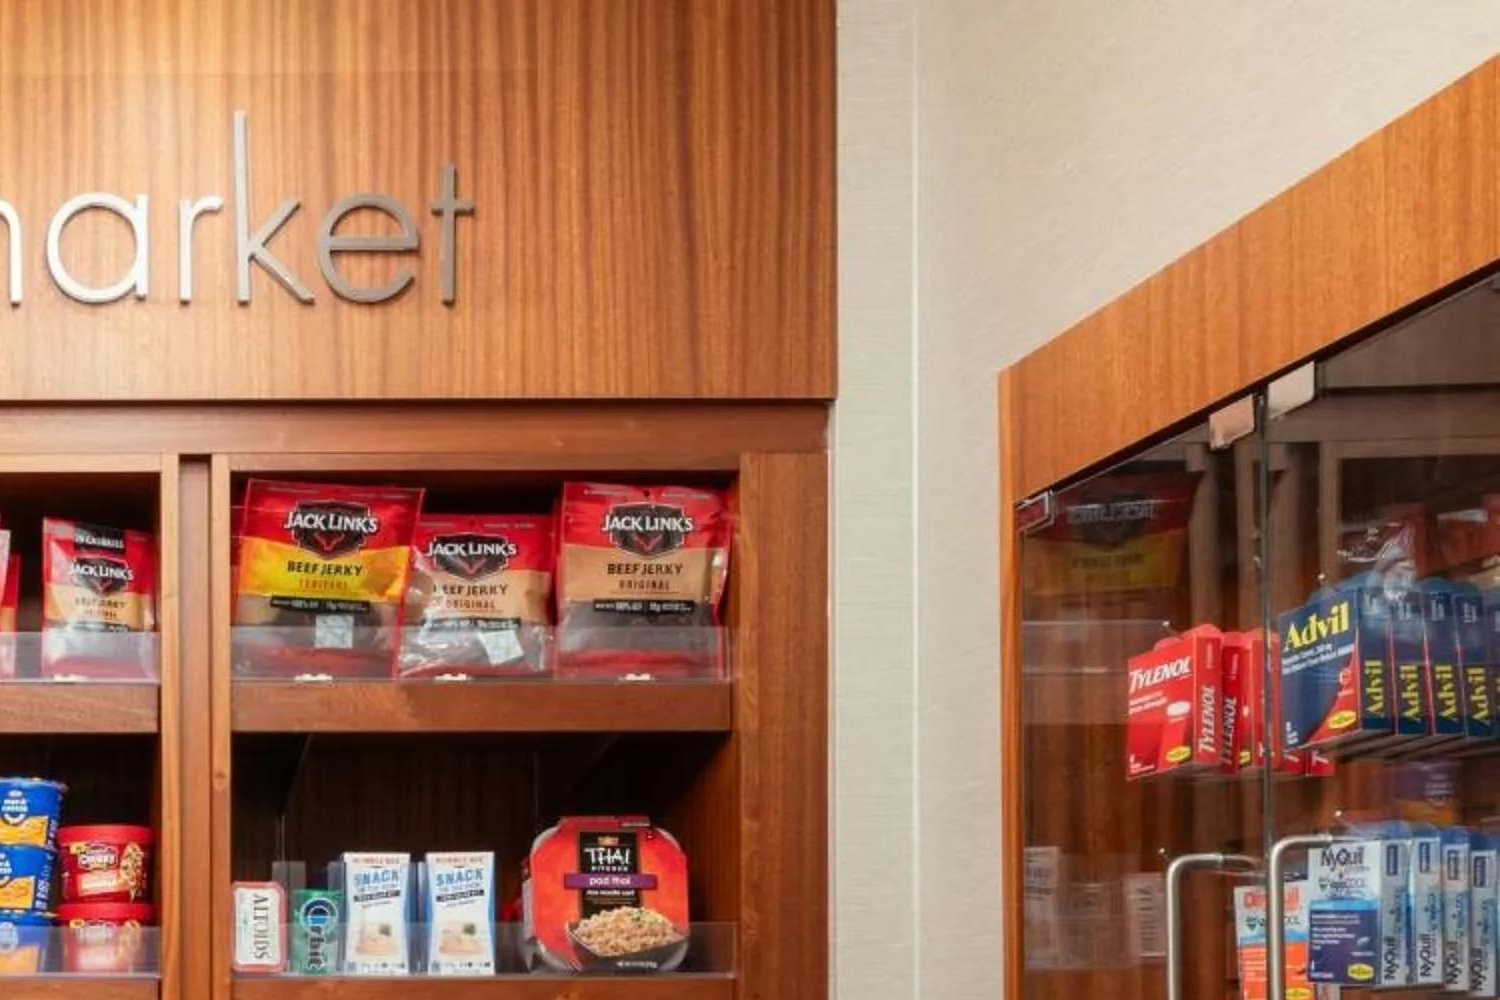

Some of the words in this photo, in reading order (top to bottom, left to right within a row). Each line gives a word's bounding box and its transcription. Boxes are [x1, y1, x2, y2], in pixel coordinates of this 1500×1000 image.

[284, 511, 327, 531] JACK
[602, 514, 645, 532] JACK
[426, 541, 465, 556] JACK
[69, 563, 99, 578] JACK
[287, 560, 319, 574] BEEF
[321, 563, 363, 577] JERKY
[607, 563, 640, 575] BEEF
[641, 563, 684, 576] JERKY
[466, 584, 509, 596] JERKY
[1284, 601, 1350, 653] Advil
[1129, 655, 1192, 695] TYLENOL
[1364, 659, 1385, 718] Advil
[1400, 664, 1421, 723] Advil
[1435, 664, 1457, 722] Advil
[1467, 666, 1491, 725] Advil
[1199, 684, 1216, 753] TYLENOL
[583, 847, 631, 865] THAI
[1320, 846, 1365, 872] NyQuil
[354, 869, 399, 887] SNACK
[436, 868, 484, 887] SNACK
[1383, 935, 1399, 981] NyQuil
[1419, 932, 1435, 978] NyQuil
